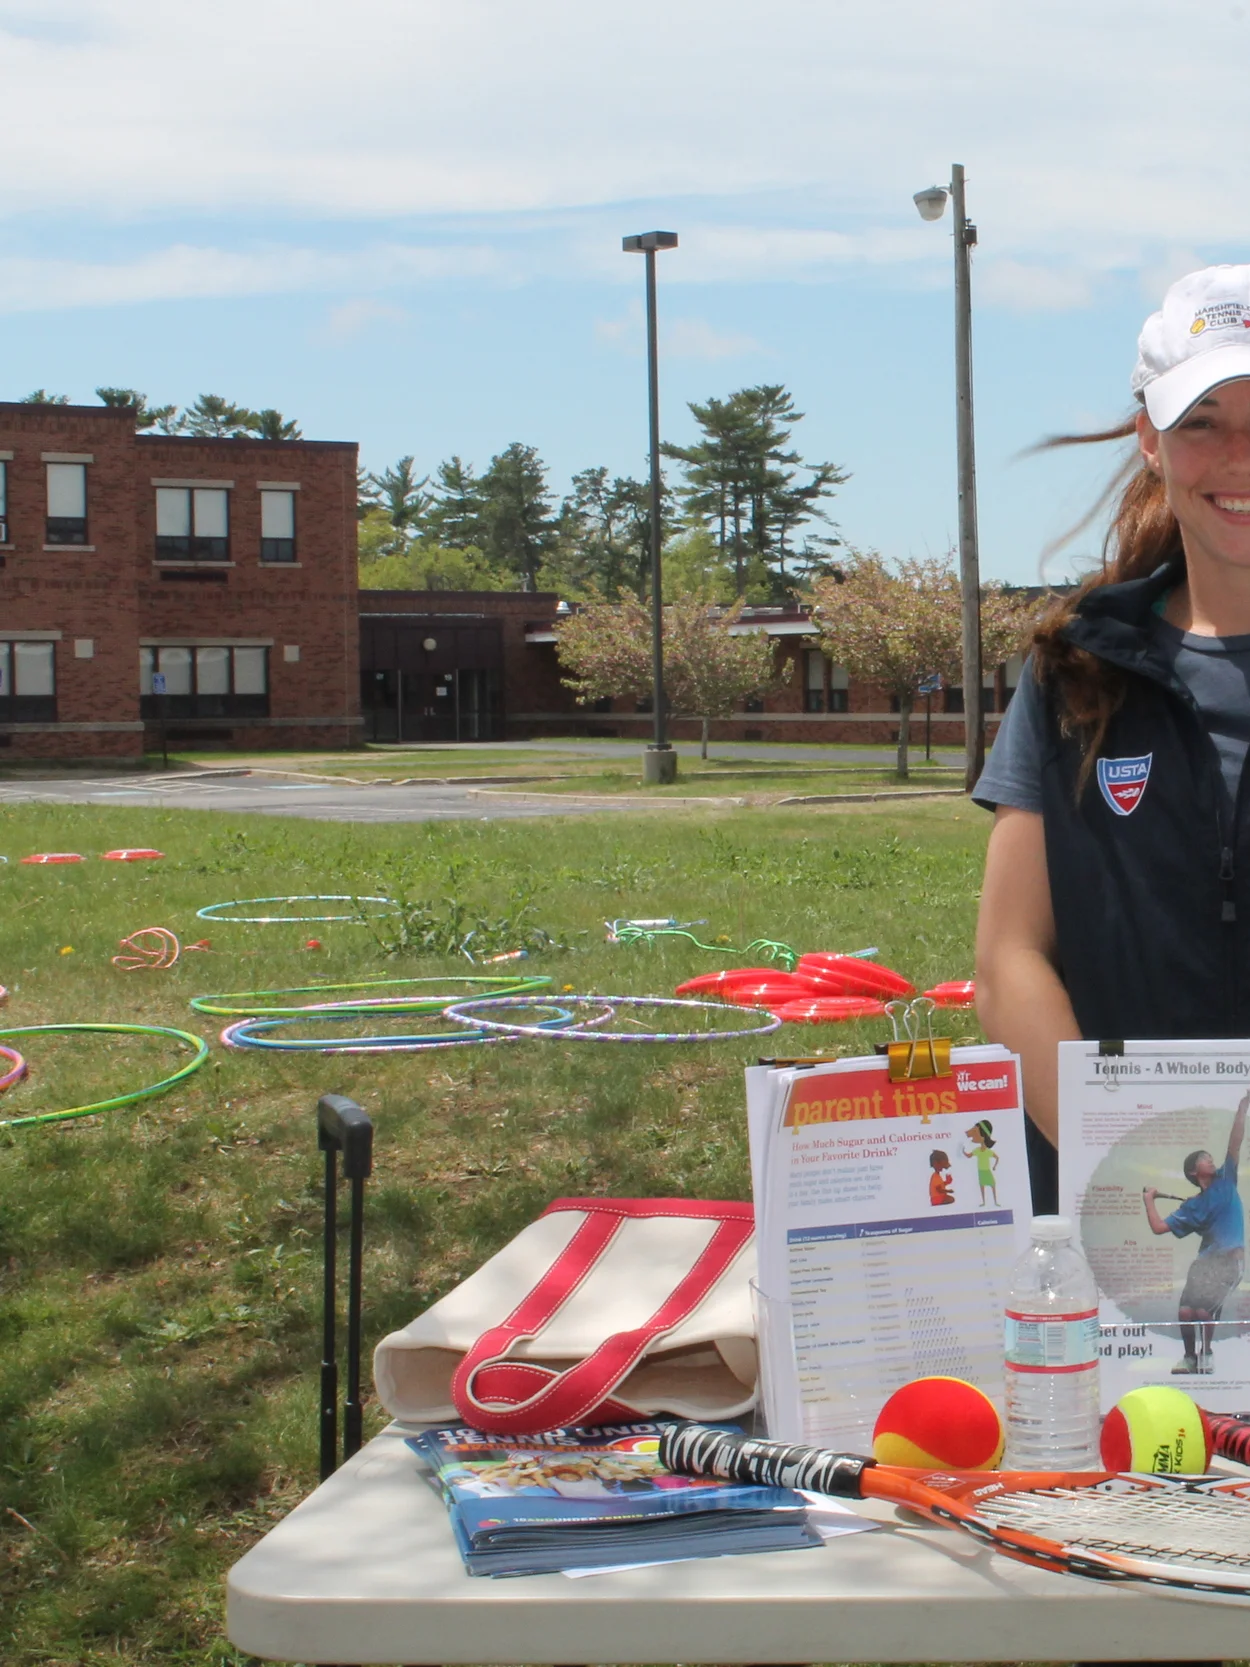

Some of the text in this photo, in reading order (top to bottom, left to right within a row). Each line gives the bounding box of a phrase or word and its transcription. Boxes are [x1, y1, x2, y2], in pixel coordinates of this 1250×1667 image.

[1206, 310, 1241, 319] TENNIS
[1210, 317, 1237, 326] CLUB
[1109, 763, 1148, 778] USTA
[1094, 1062, 1141, 1075] Tennis
[1154, 1062, 1164, 1075] A
[1167, 1061, 1210, 1075] Whole
[1216, 1061, 1250, 1077] Body
[792, 1085, 957, 1135] parent tips
[792, 1142, 811, 1151] How
[813, 1138, 835, 1149] Much
[837, 1137, 864, 1148] Sugar
[867, 1134, 886, 1144] and
[889, 1131, 932, 1143] Calories
[801, 1154, 820, 1164] Your
[822, 1151, 860, 1162] Favorite
[863, 1147, 898, 1158] Drink?
[1123, 1325, 1147, 1337] out
[1118, 1344, 1153, 1359] play!
[575, 1421, 671, 1437] UNDE
[439, 1432, 580, 1447] TENNIS
[1174, 1438, 1184, 1466] KIDS
[973, 1482, 1005, 1496] HEAD
